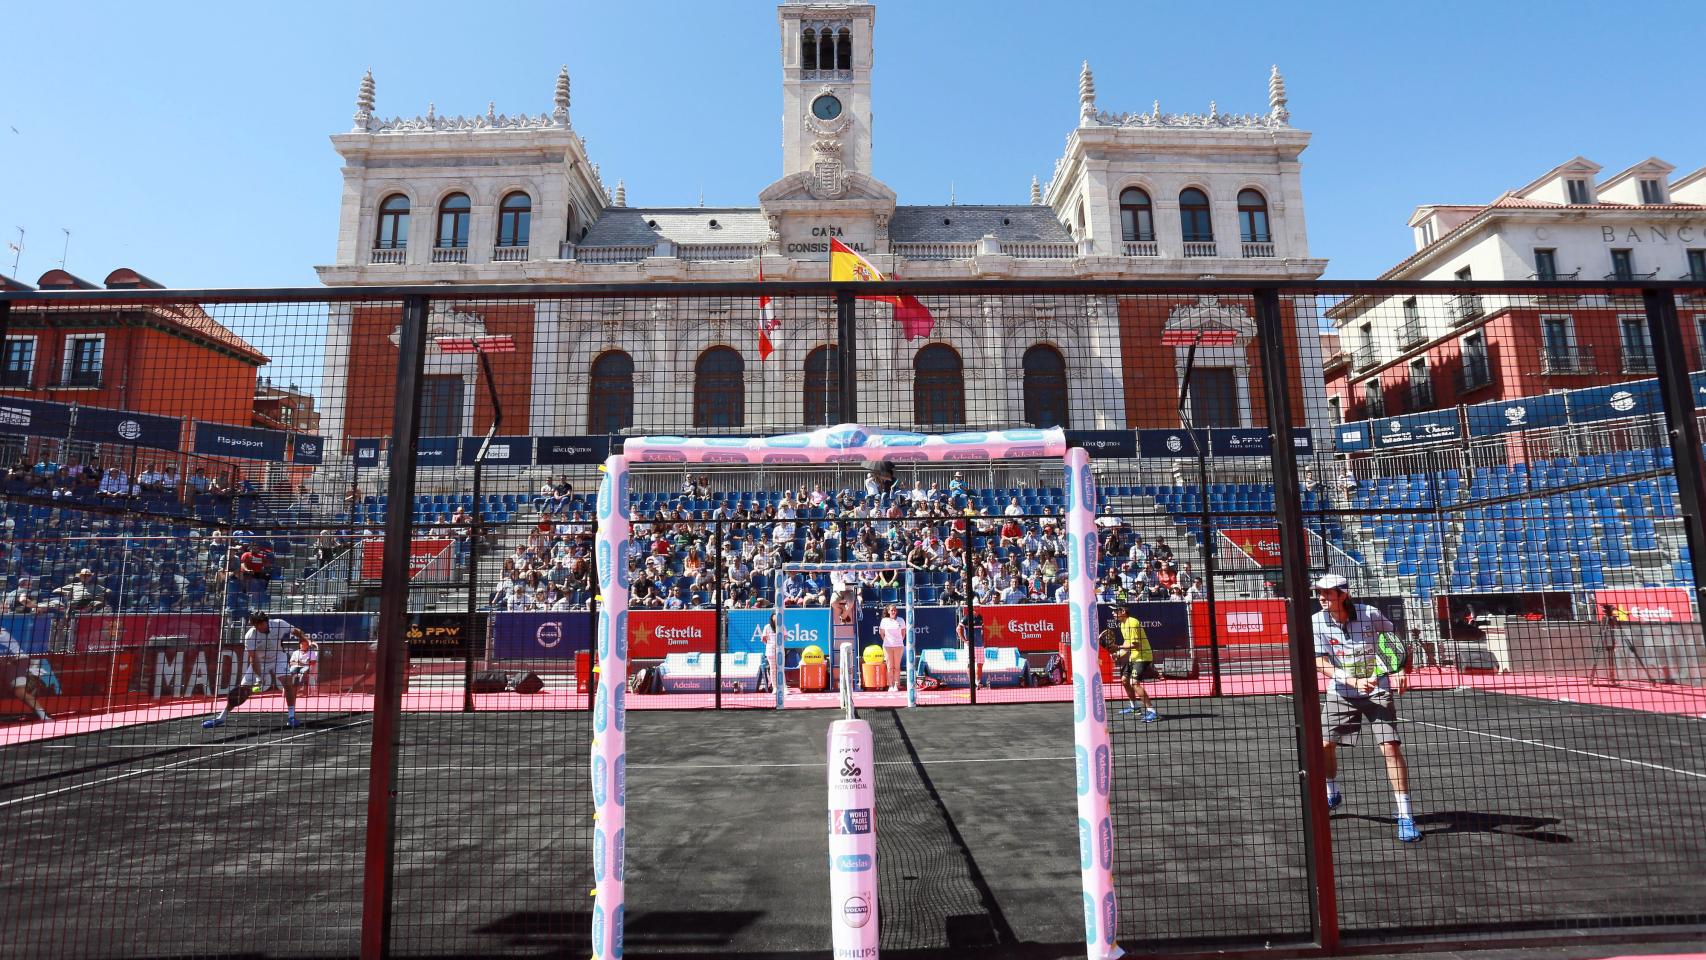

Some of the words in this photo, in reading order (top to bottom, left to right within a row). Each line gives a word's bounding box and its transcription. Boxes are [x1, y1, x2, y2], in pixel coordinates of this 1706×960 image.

[812, 227, 844, 237] CASA
[1600, 225, 1706, 243] BANC
[788, 243, 869, 252] CONSISRIAL
[1631, 607, 1672, 618] Estrella
[425, 627, 460, 636] PPW
[1008, 619, 1055, 632] Estrella
[655, 625, 702, 639] Estrella
[750, 623, 819, 642] Aslas
[673, 681, 700, 689] Adeslas
[1099, 752, 1107, 788] Adeslas
[839, 946, 876, 958] PHILIPS
